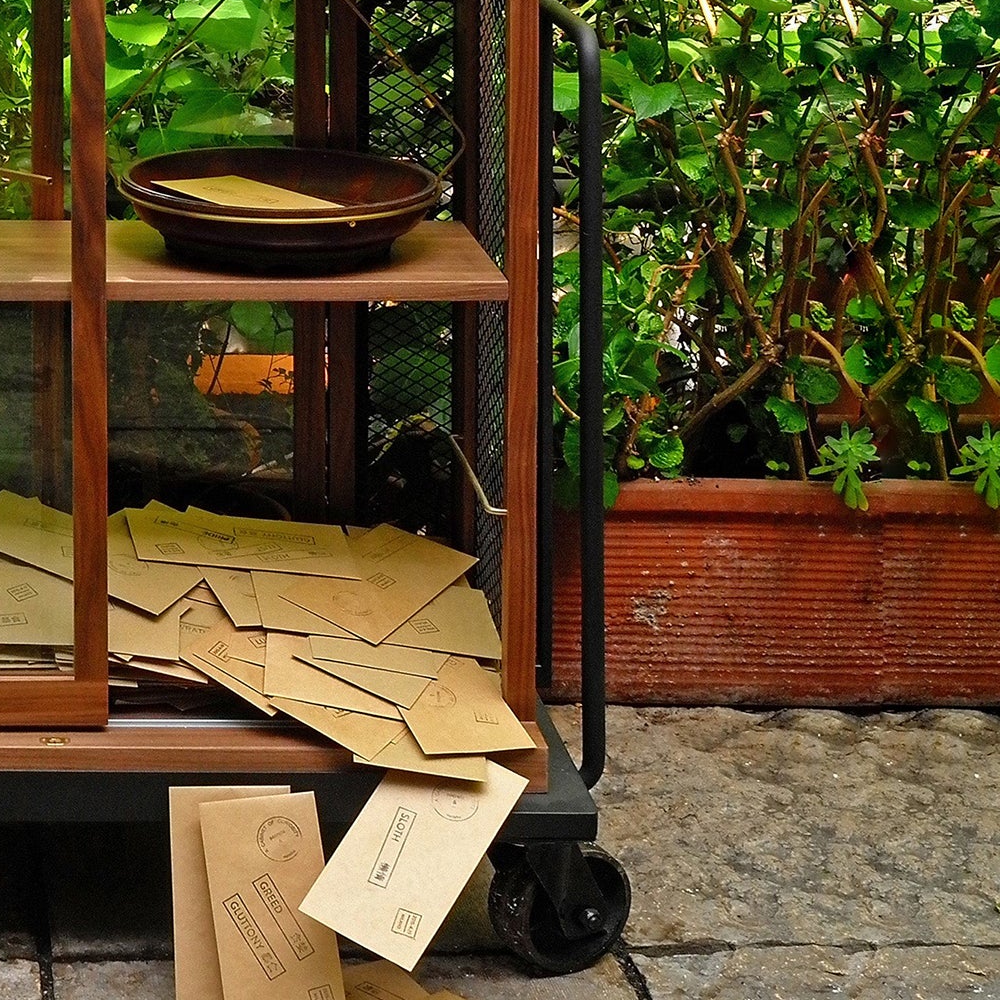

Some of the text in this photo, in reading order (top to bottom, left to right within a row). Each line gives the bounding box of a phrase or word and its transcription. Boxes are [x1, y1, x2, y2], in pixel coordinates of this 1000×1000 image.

[391, 812, 410, 843] SLOTH
[259, 881, 283, 914] GREED
[230, 901, 265, 950] GLUTTONY
